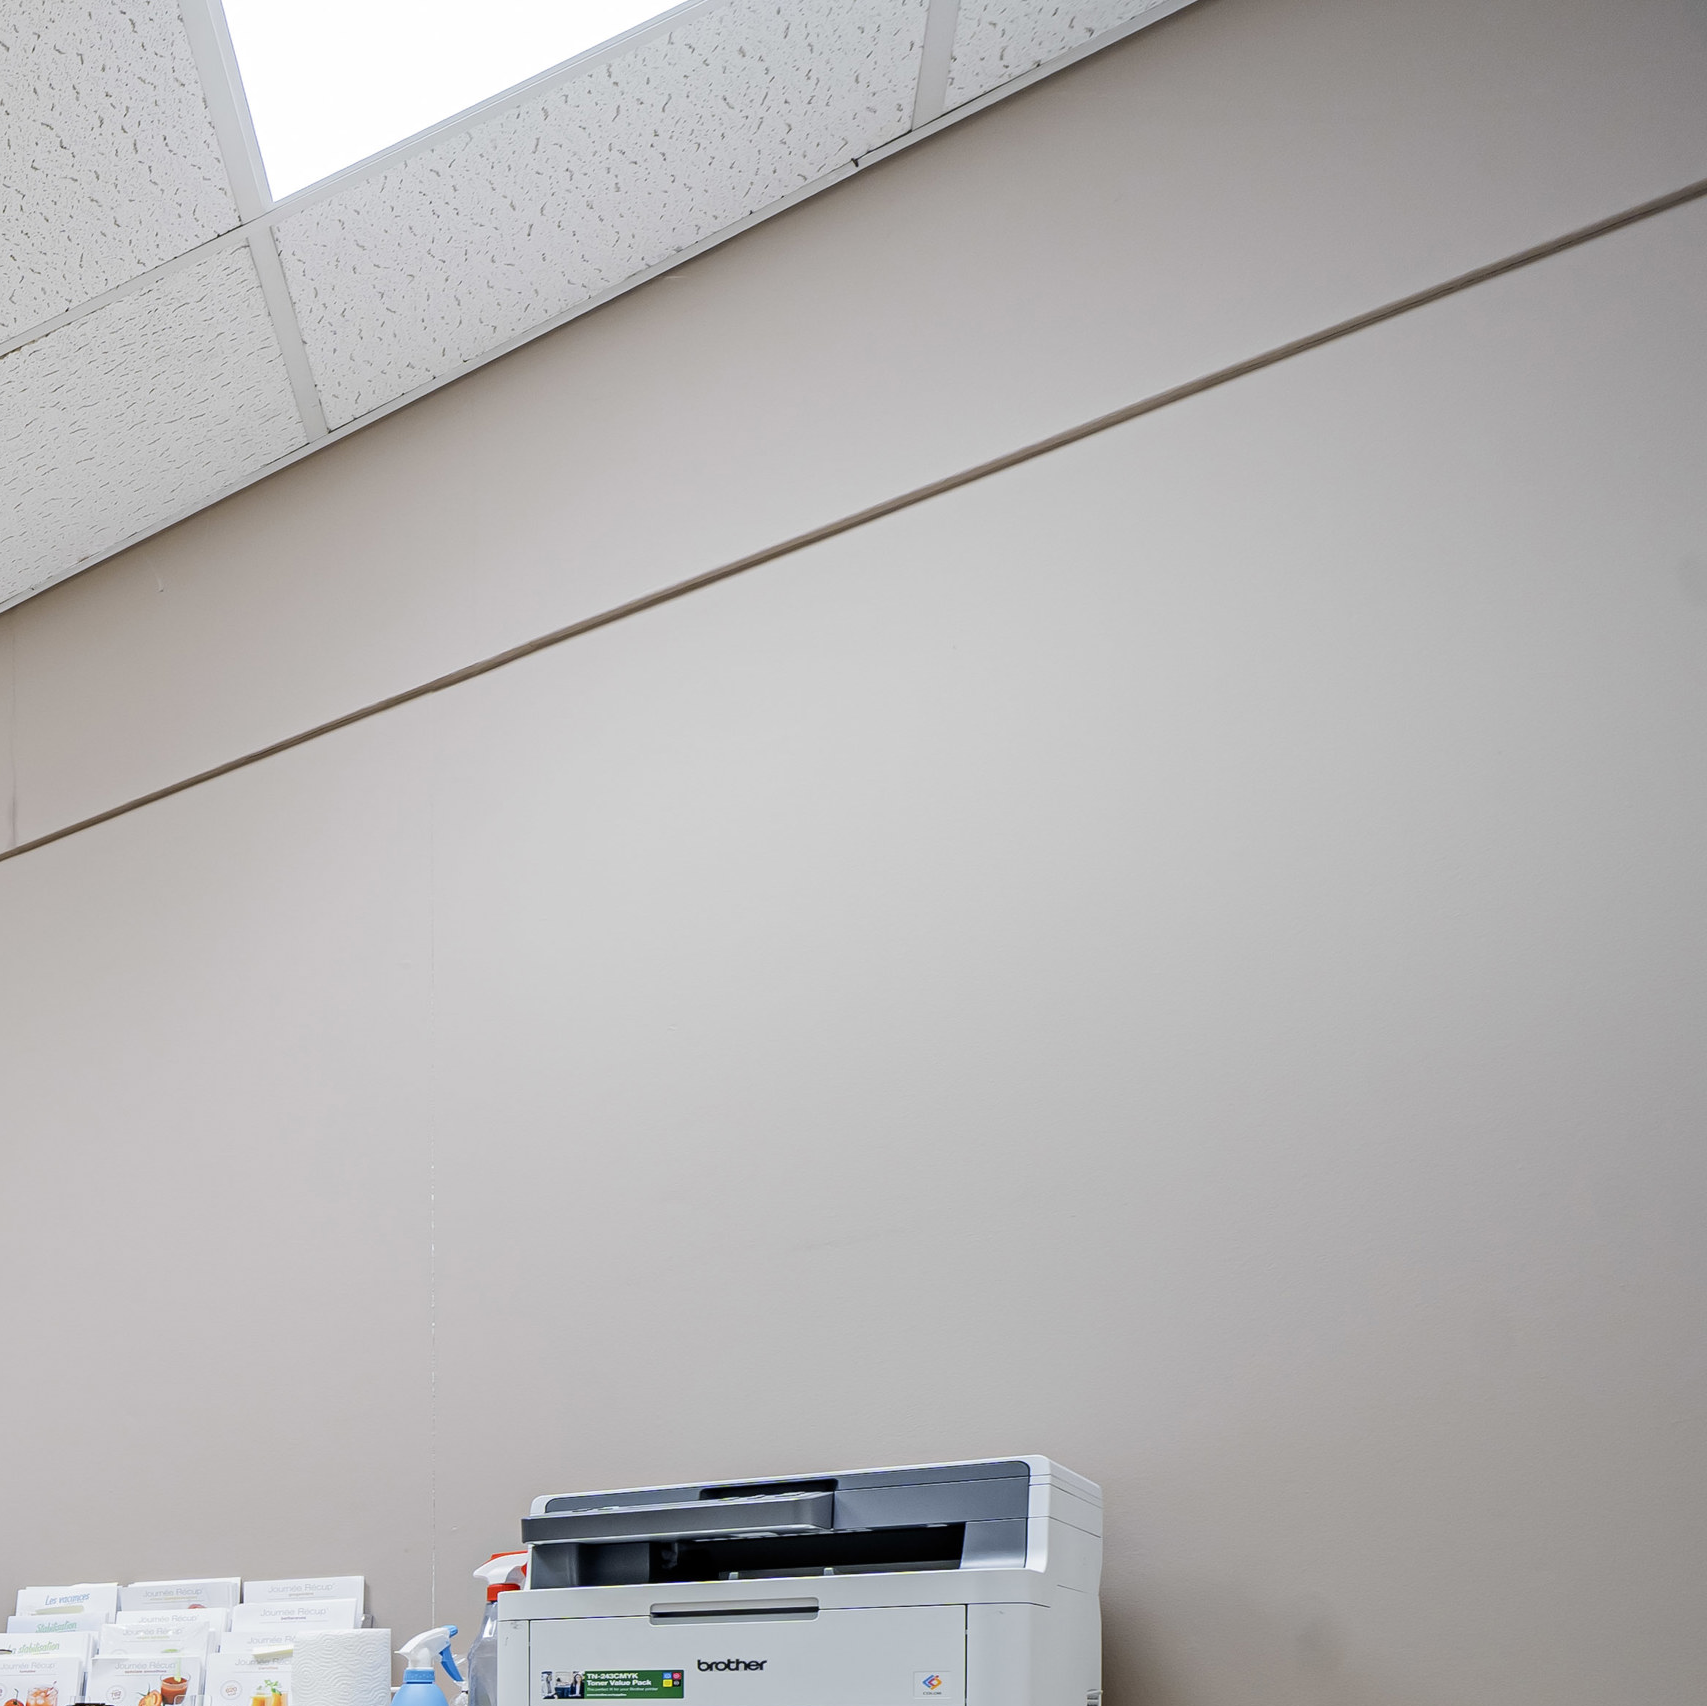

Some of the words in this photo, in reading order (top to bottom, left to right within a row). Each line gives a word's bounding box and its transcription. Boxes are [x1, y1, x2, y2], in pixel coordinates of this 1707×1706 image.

[45, 1595, 57, 1606] Les
[59, 1592, 90, 1604] vacances
[697, 1659, 767, 1672] brother
